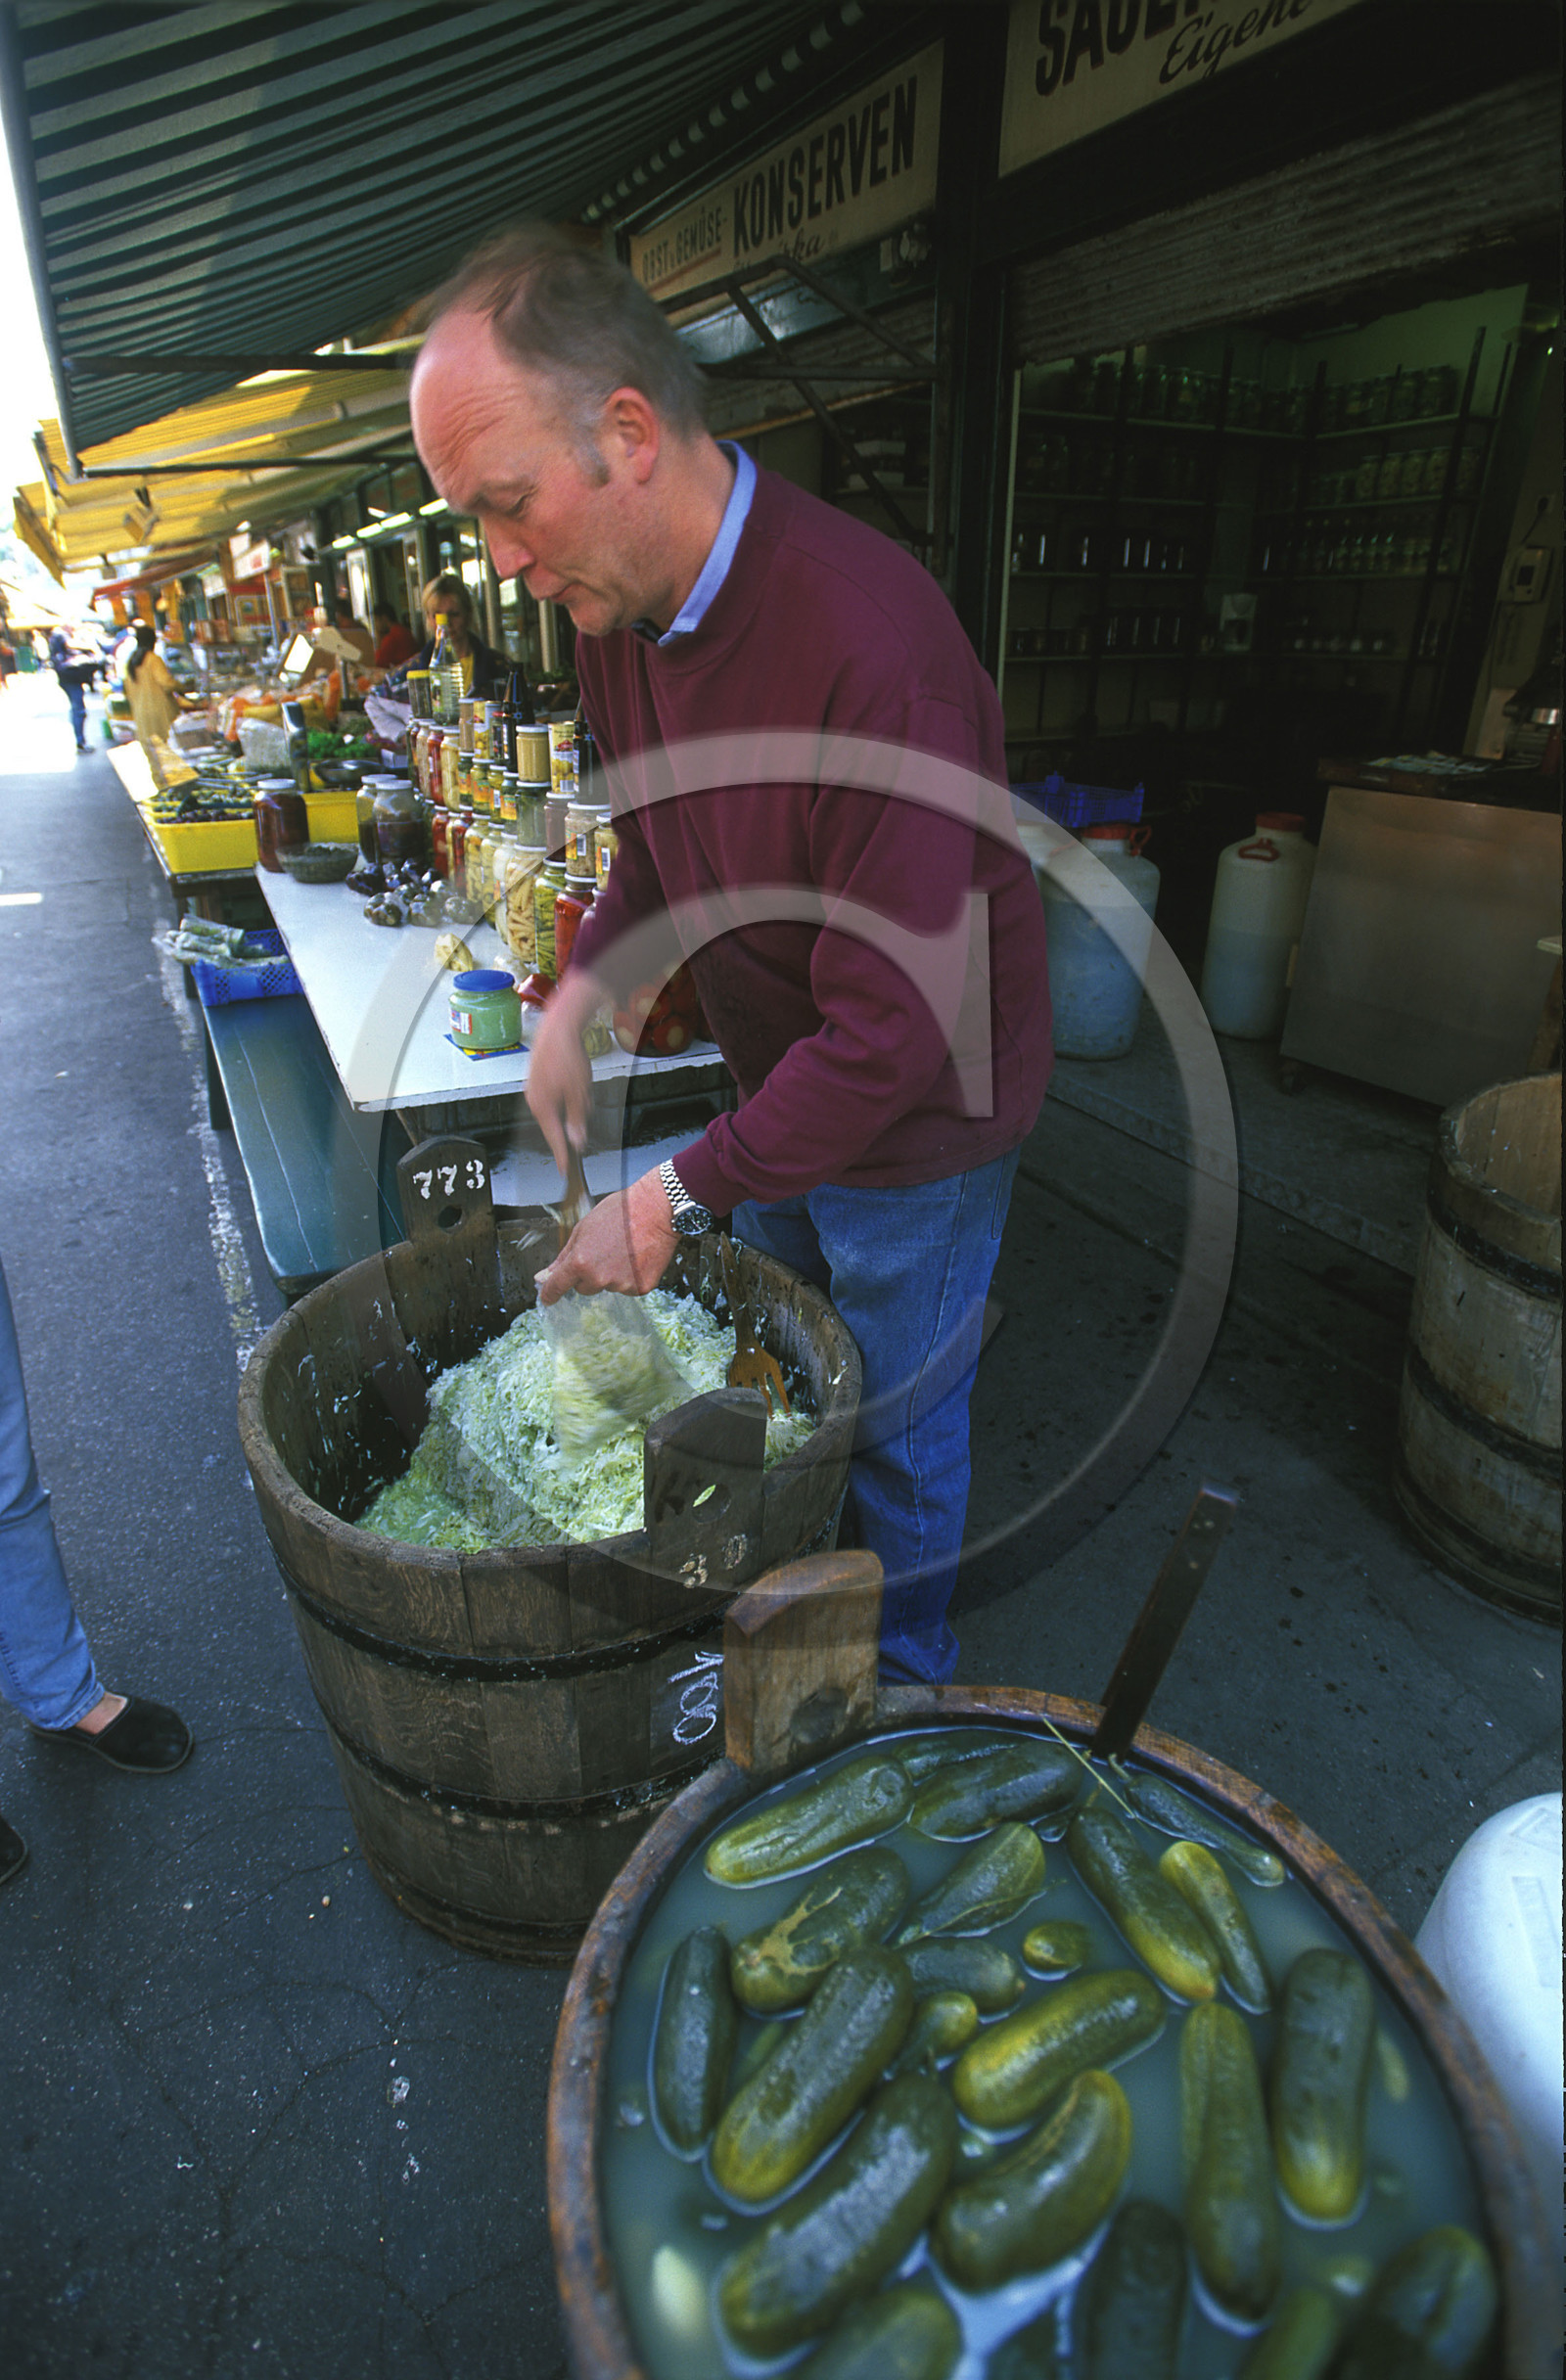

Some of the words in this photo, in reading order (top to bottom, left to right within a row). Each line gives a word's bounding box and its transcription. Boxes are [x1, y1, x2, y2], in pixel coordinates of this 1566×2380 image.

[642, 239, 668, 283] OBST
[734, 74, 918, 257] KONSERVEN
[412, 1159, 485, 1200] 773
